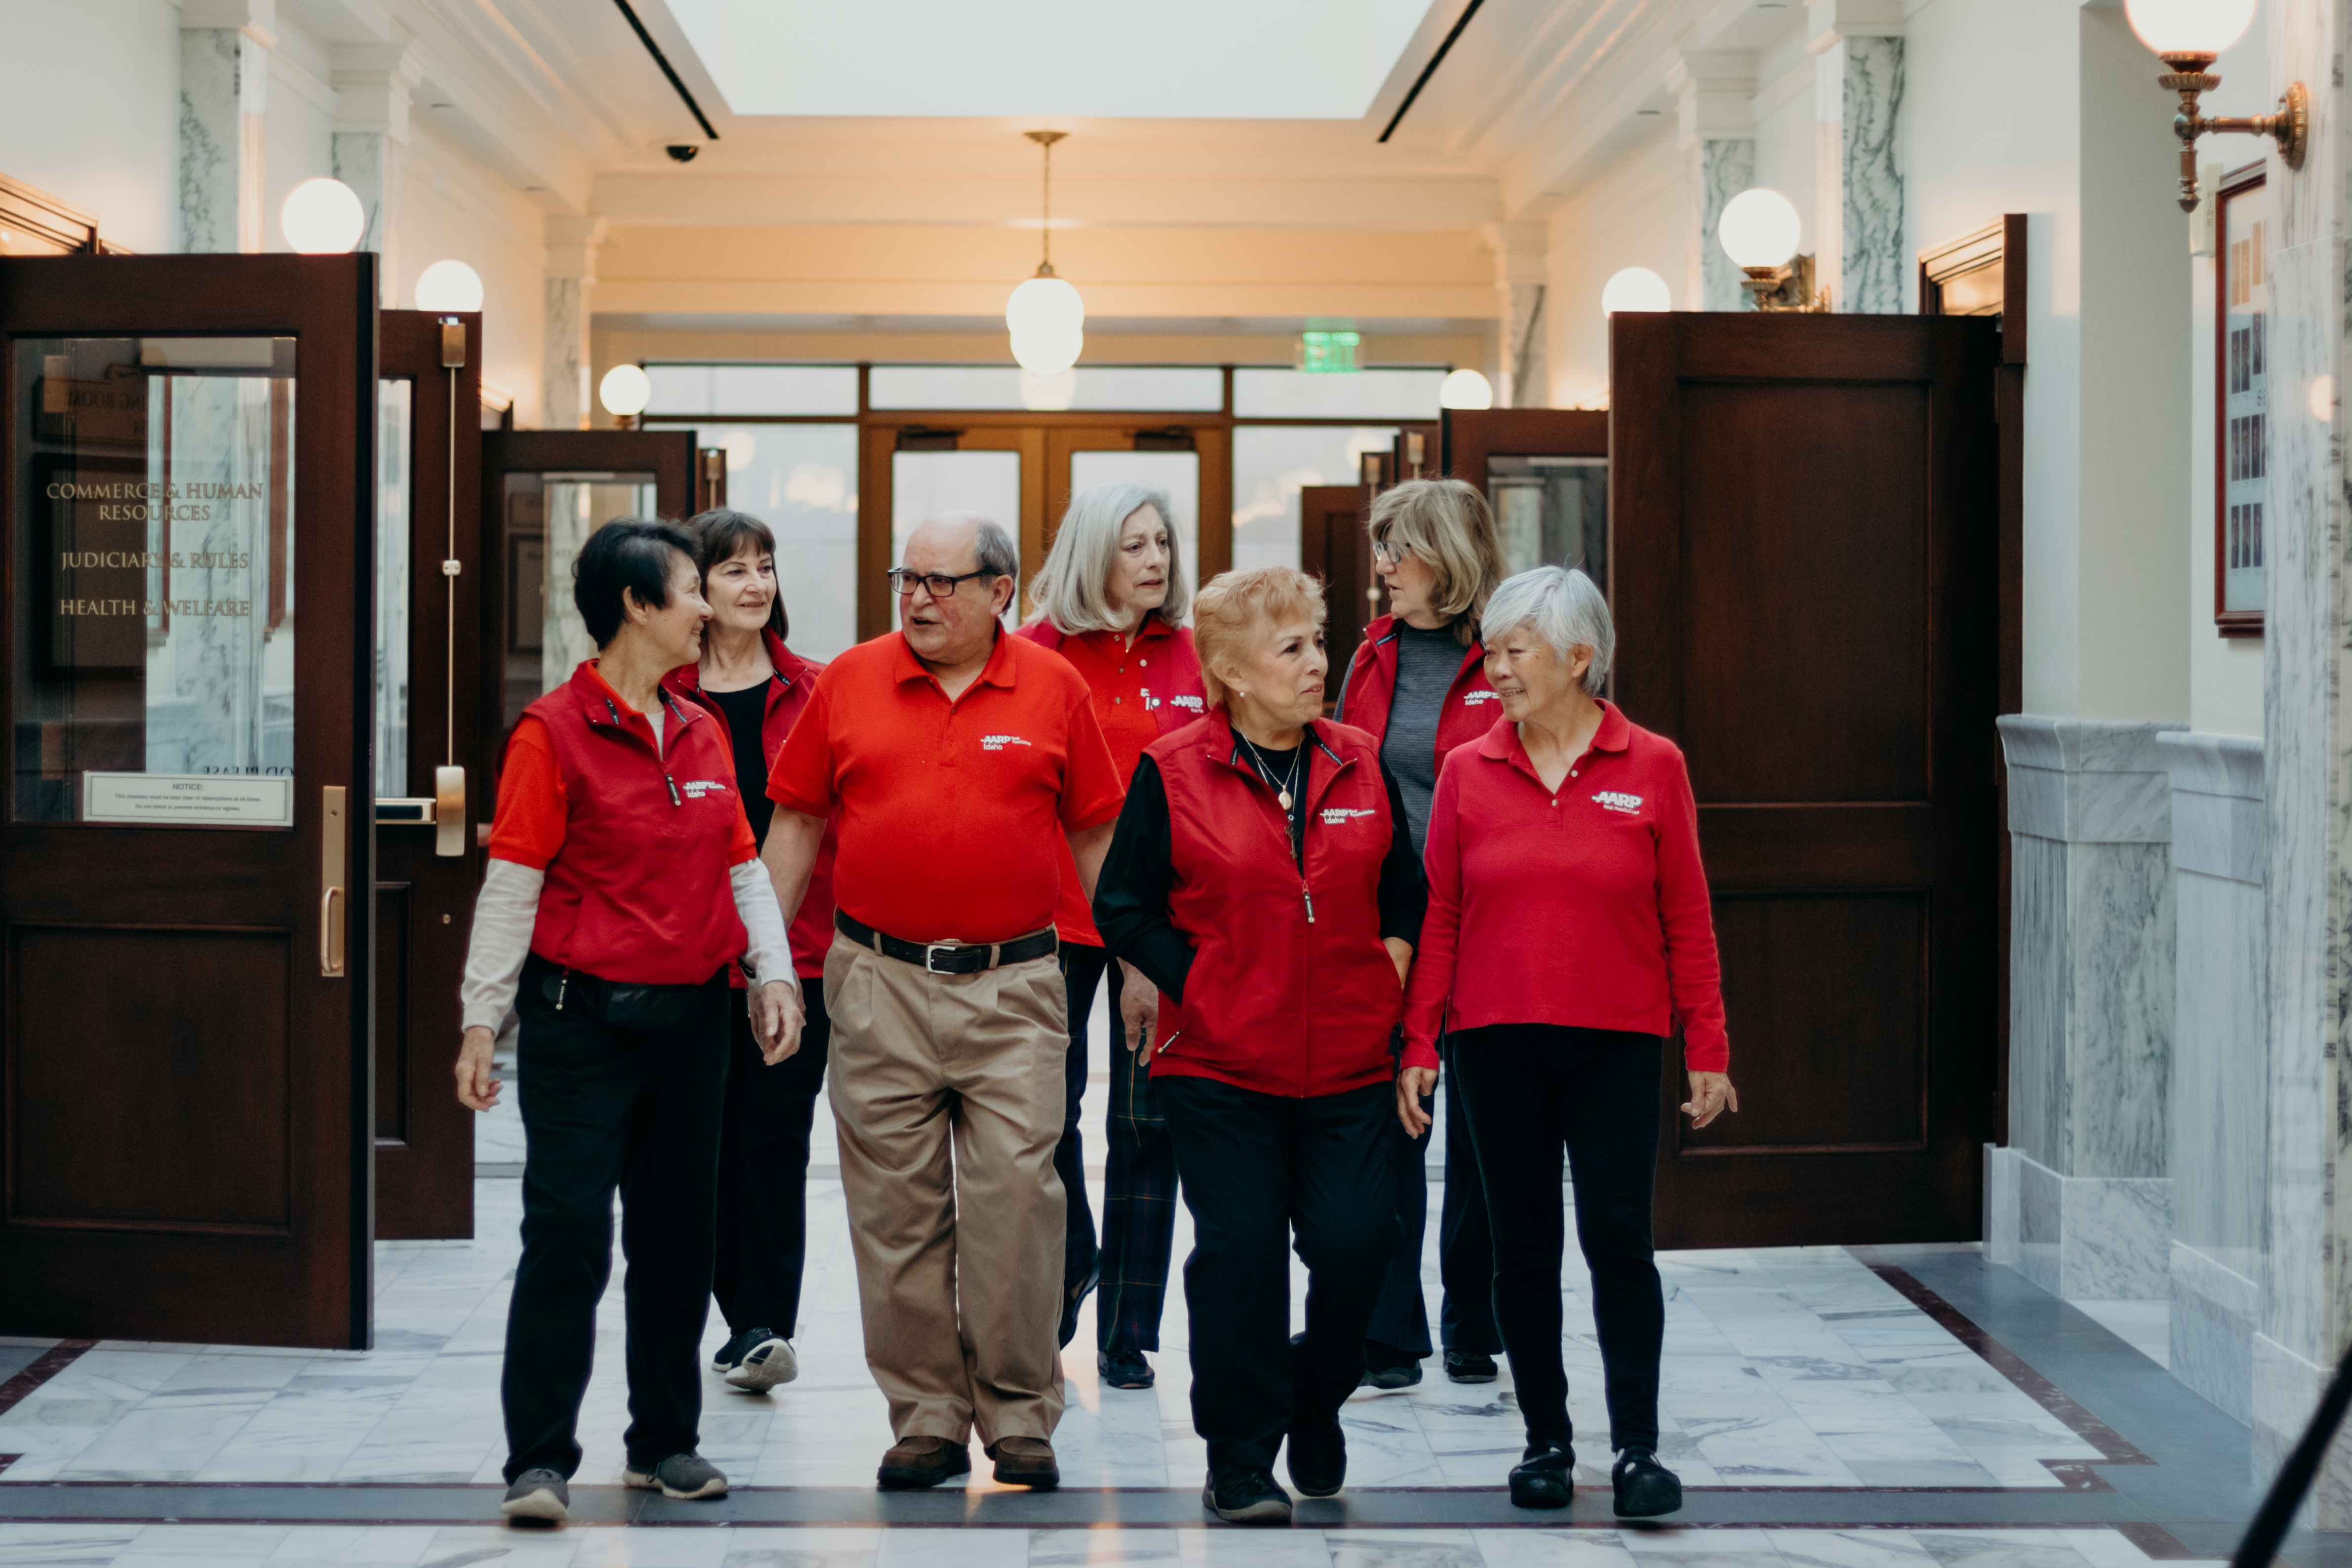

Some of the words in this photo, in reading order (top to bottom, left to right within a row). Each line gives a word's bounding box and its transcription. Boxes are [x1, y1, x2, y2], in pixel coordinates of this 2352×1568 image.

[46, 483, 159, 499] COMMERCE
[166, 483, 181, 499] &
[185, 483, 263, 500] HUMAN
[99, 505, 211, 521] RESOURCES
[62, 552, 164, 571] JUDICIARY
[169, 552, 186, 568] &
[190, 552, 248, 568] RULES
[60, 600, 136, 615] HEALTH
[143, 600, 158, 616] &
[162, 600, 249, 616] WELFARE
[1171, 695, 1203, 708] AARP
[1464, 691, 1491, 700] AARP
[981, 735, 1011, 744] AARP
[683, 781, 707, 791] AARP
[1592, 791, 1641, 809] AARP
[1319, 809, 1349, 817] AARP
